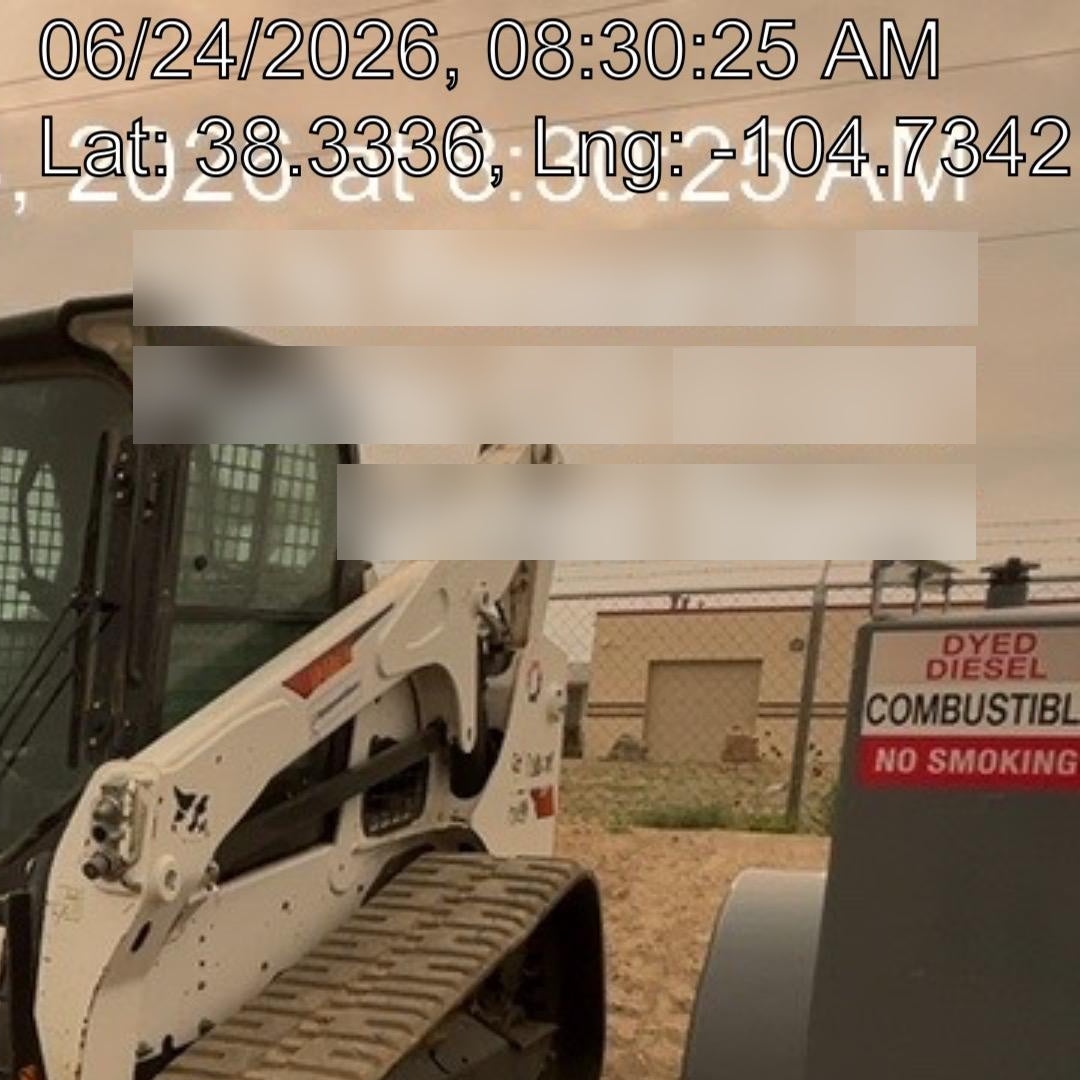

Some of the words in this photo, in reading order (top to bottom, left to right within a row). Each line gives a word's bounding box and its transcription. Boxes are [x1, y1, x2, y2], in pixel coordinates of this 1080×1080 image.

[943, 632, 1038, 655] DYED
[926, 657, 1047, 680] DIESEL
[875, 748, 917, 773] NO
[926, 747, 1078, 776] SMOKING
